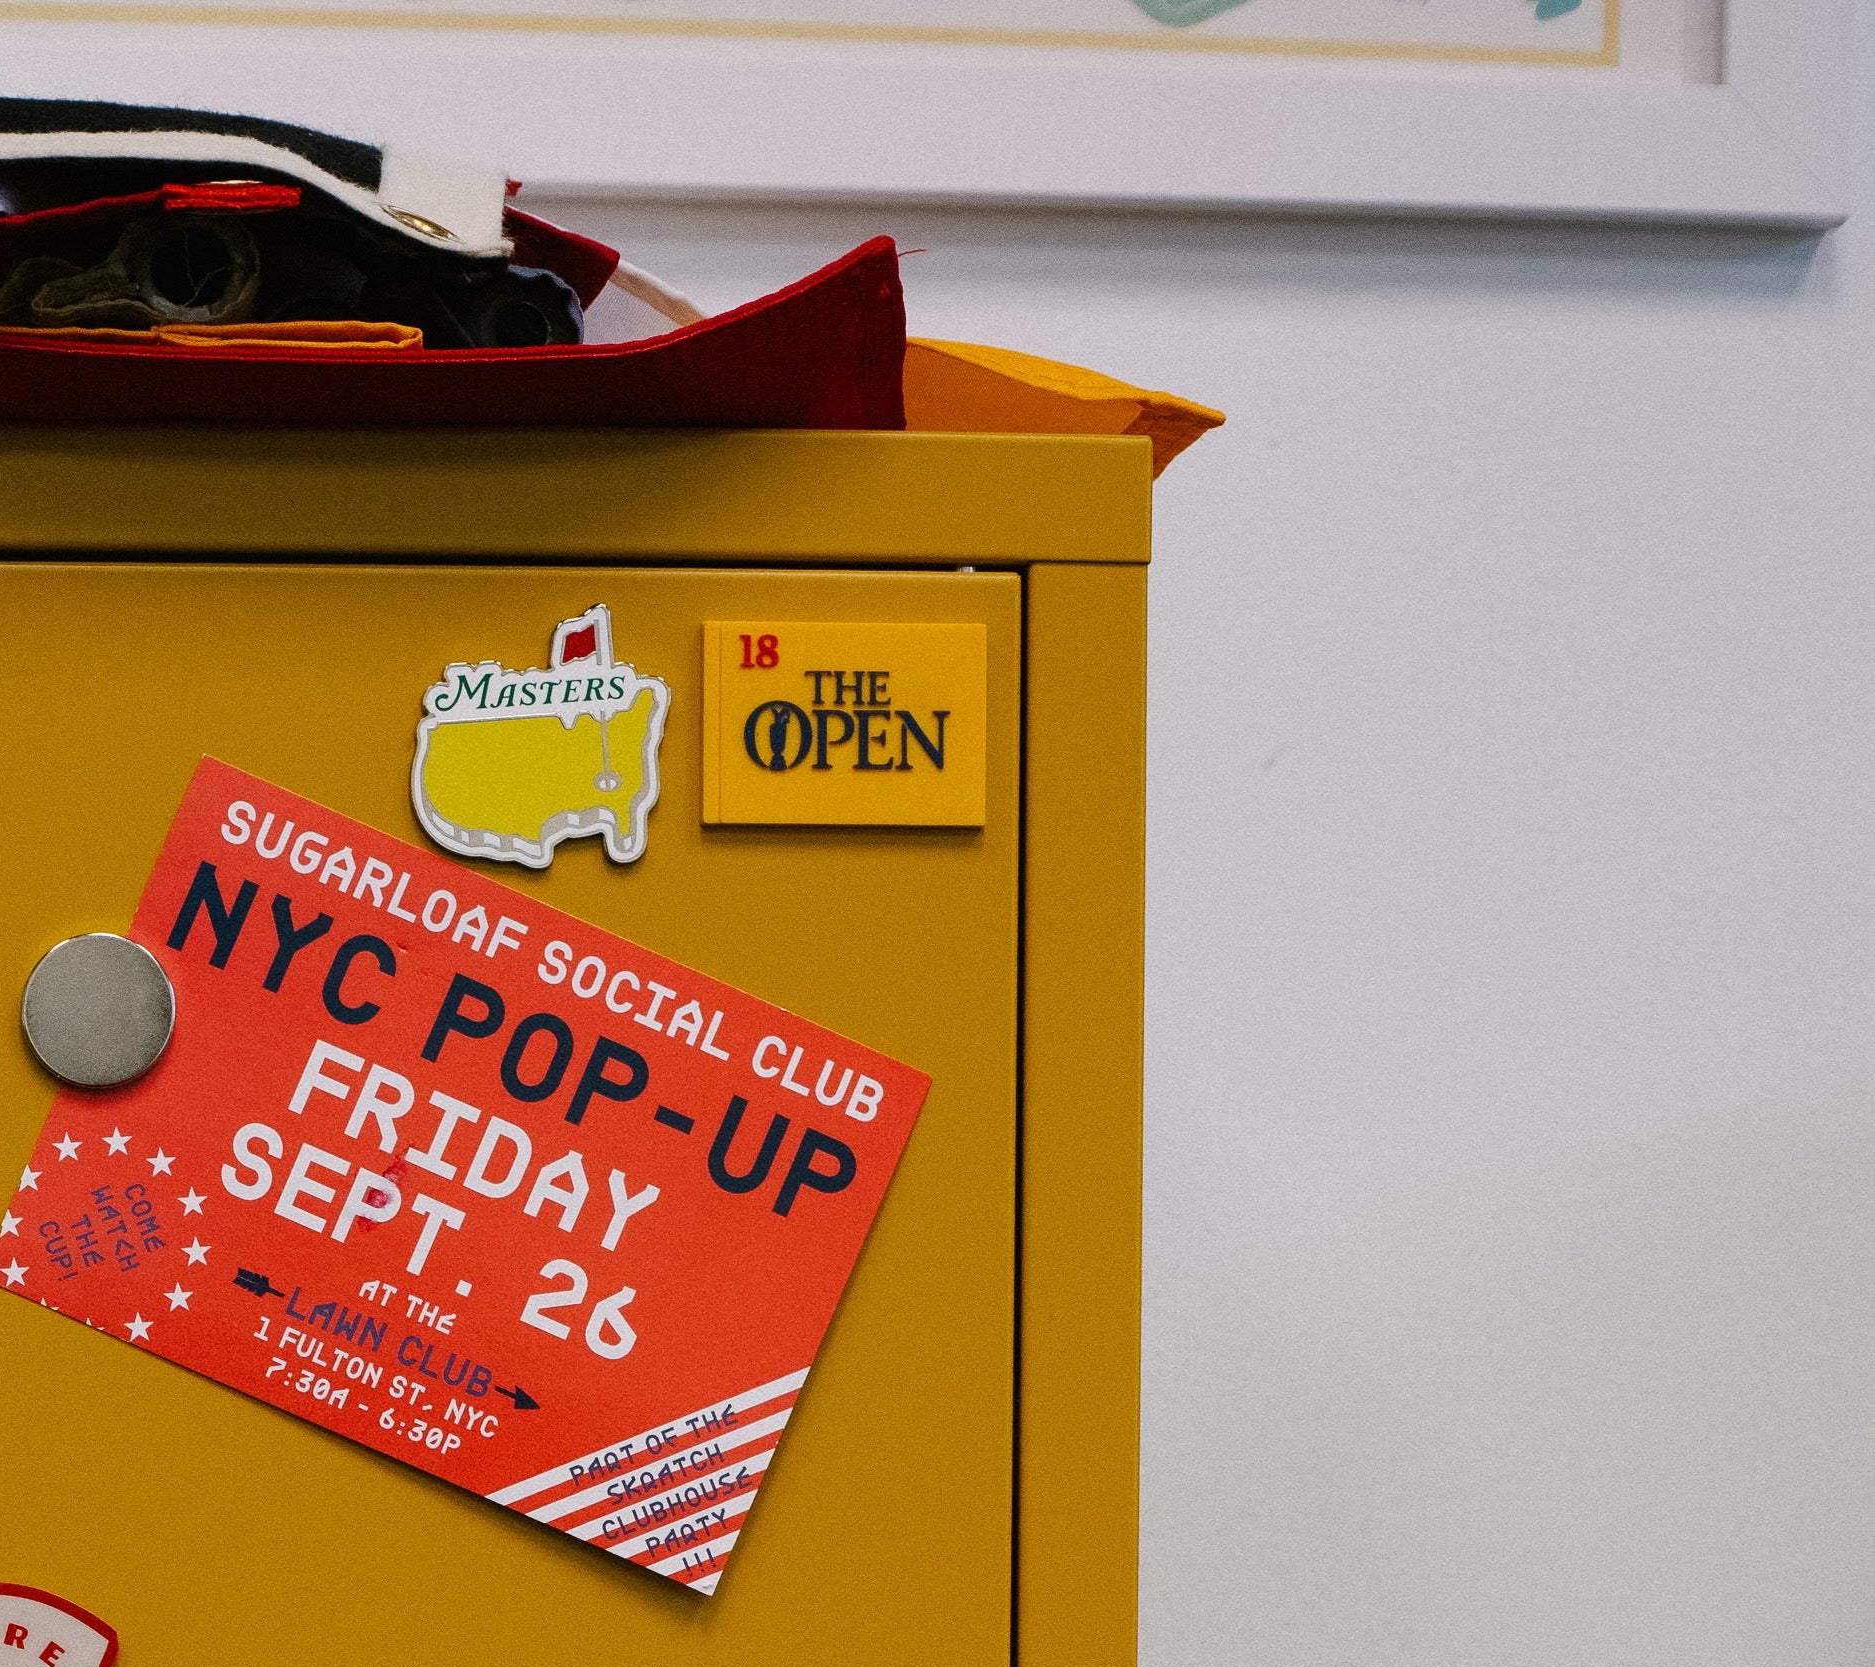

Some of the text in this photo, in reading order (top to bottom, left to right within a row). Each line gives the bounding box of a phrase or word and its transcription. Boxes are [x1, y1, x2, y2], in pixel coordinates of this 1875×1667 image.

[738, 633, 780, 669] 18
[805, 670, 892, 706] THE
[434, 672, 627, 712] MASTERS
[743, 699, 951, 772] OPEN
[221, 800, 885, 1122] SUGARLOAF SOCIAL CLUB
[165, 860, 858, 1217] NYC POP-UP
[287, 1039, 661, 1253] FRIDAY
[38, 1220, 79, 1283] CUP!
[69, 1214, 106, 1268] THE
[91, 1184, 140, 1274] WATCH
[124, 1182, 167, 1254] COME
[220, 1122, 638, 1361] SEPT. 26
[285, 1287, 494, 1399] LAWN CLUB
[358, 1279, 457, 1335] AT THE
[253, 1315, 270, 1342] 1
[277, 1324, 385, 1395] FULTON
[444, 1398, 500, 1439] NYC
[264, 1356, 352, 1410] 7:30A
[378, 1407, 462, 1456] 6:30P
[568, 1404, 739, 1487] PART OF THE
[606, 1442, 726, 1506] SKRATCH
[601, 1466, 754, 1541] CLUBHOUSE
[644, 1508, 728, 1559] PARTY
